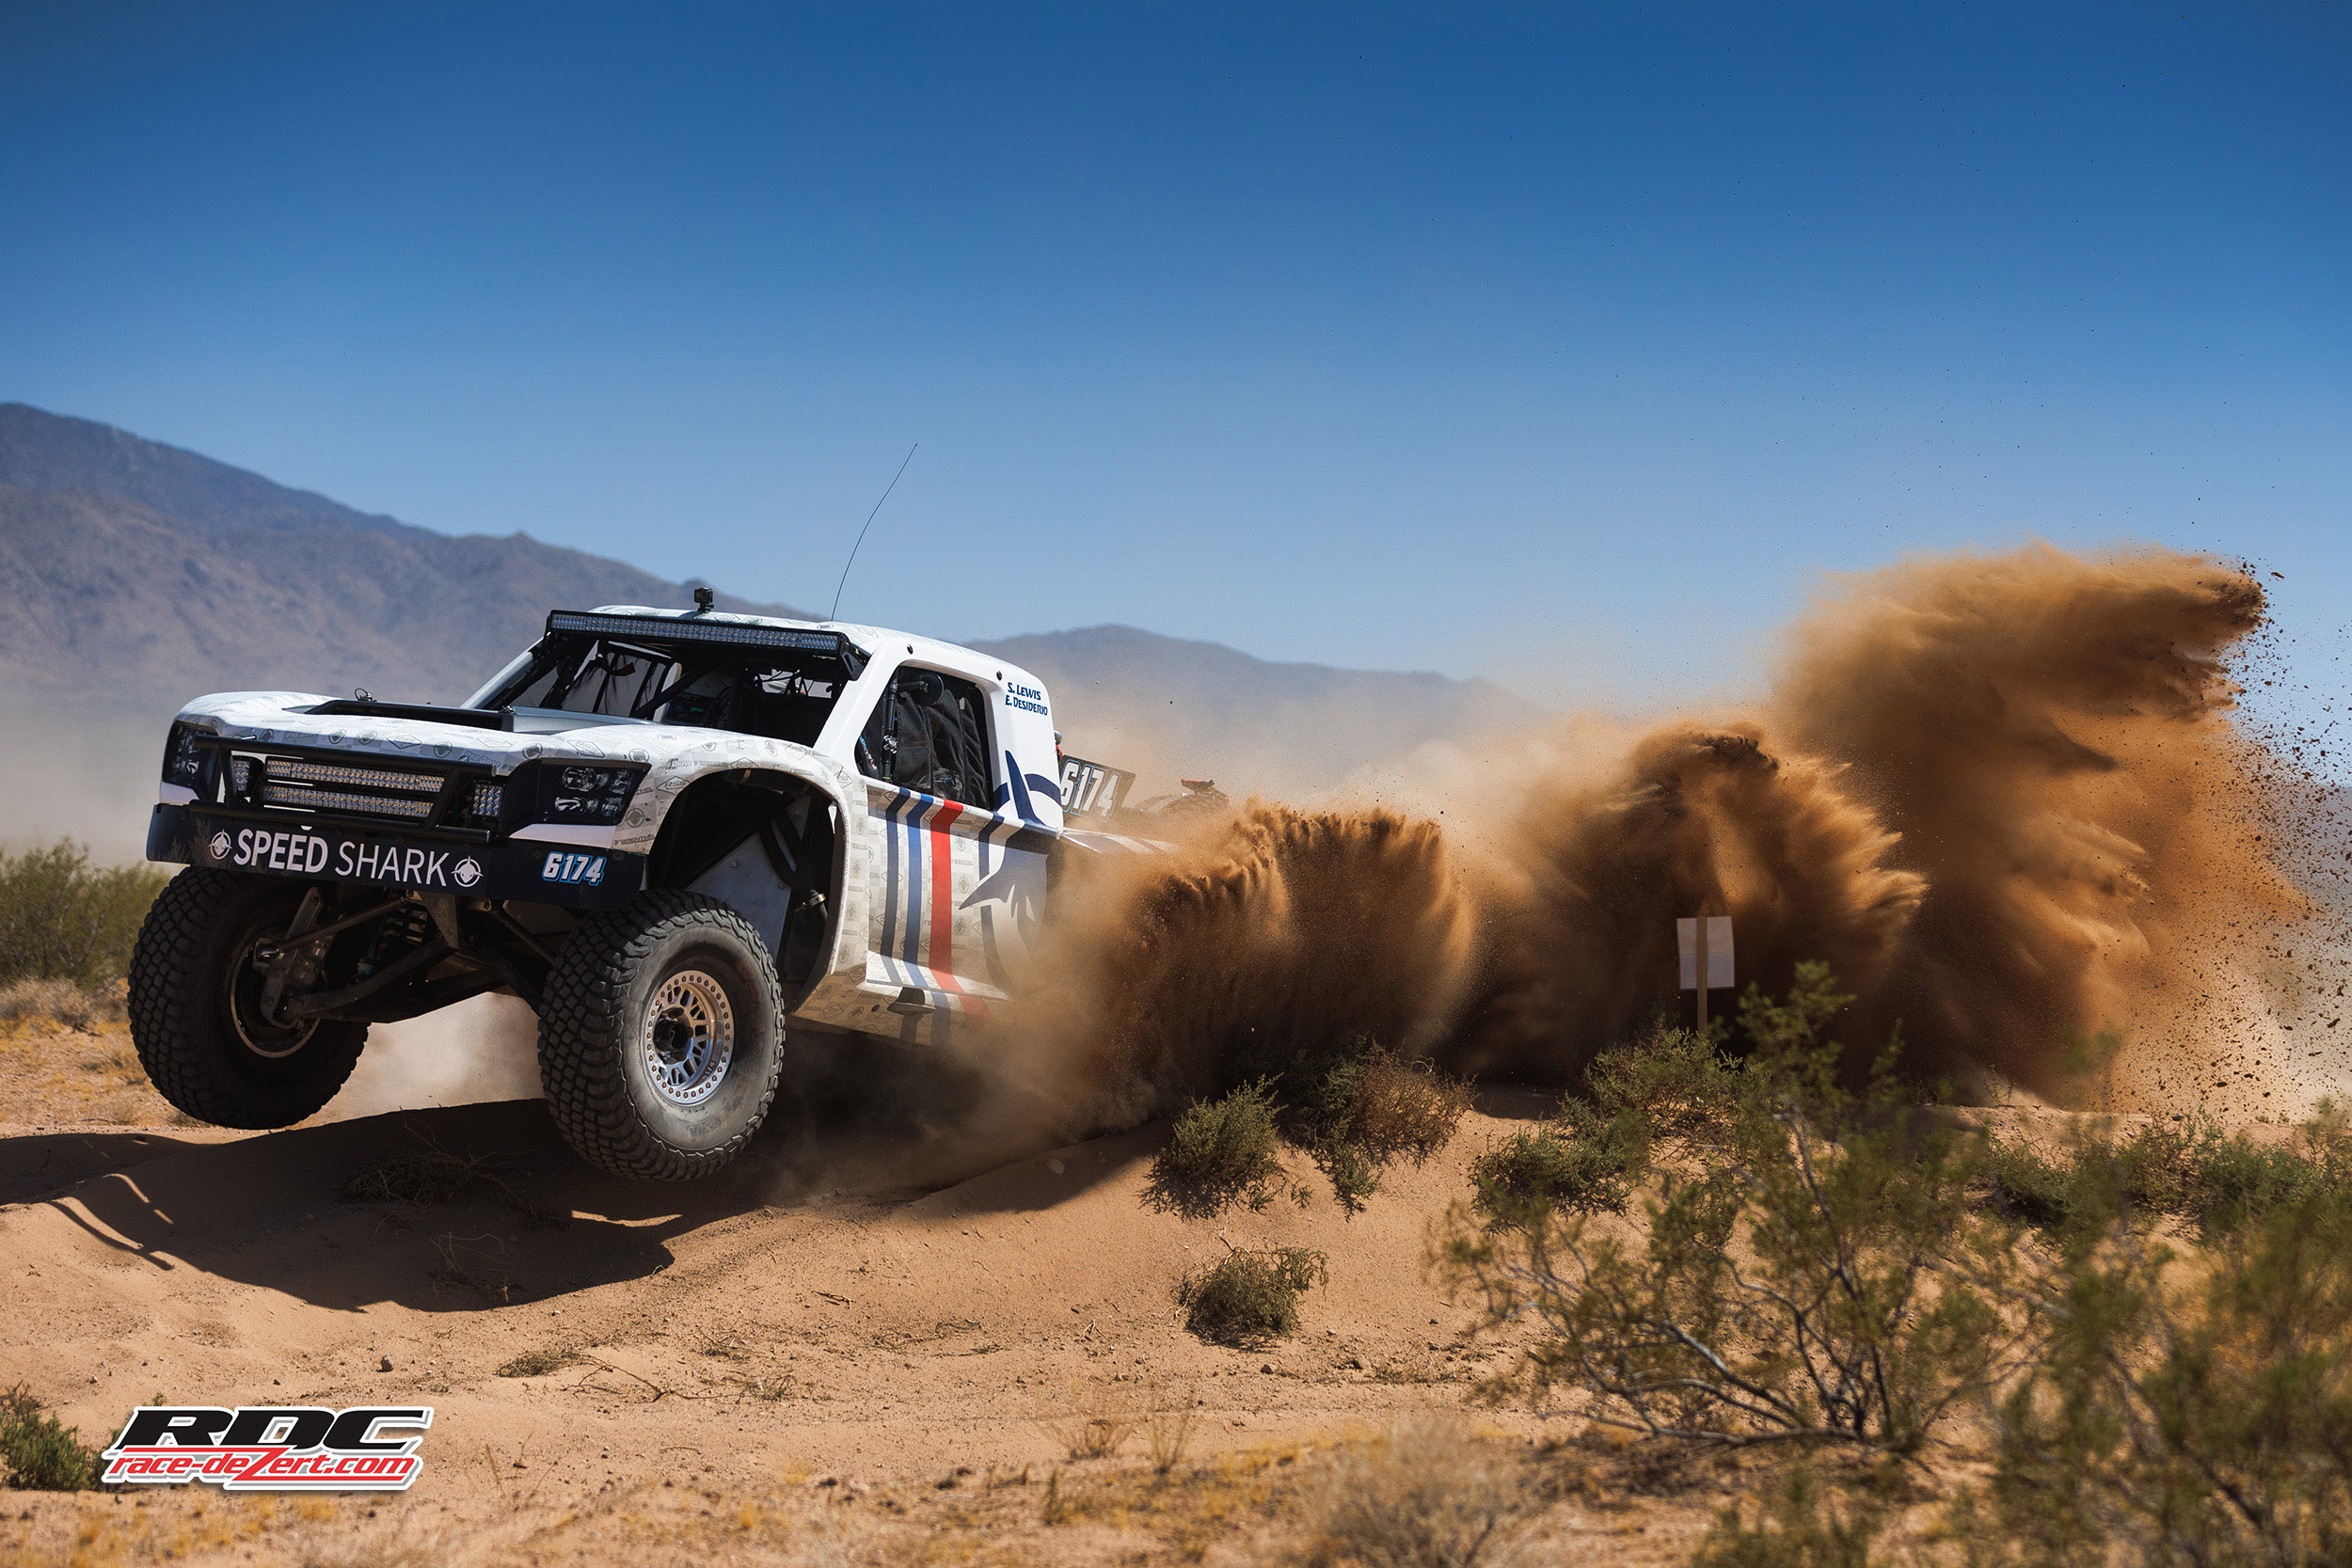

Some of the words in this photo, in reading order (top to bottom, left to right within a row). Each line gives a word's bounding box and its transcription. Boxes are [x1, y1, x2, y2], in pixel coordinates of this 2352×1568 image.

[1005, 694, 1013, 706] E.
[1012, 696, 1049, 716] DESIDERIO
[1007, 681, 1016, 694] S.
[1016, 684, 1041, 701] LEWIS
[1060, 759, 1120, 821] 6174
[231, 828, 329, 874] SPEED
[335, 840, 449, 887] SHARK
[540, 850, 607, 885] 6174
